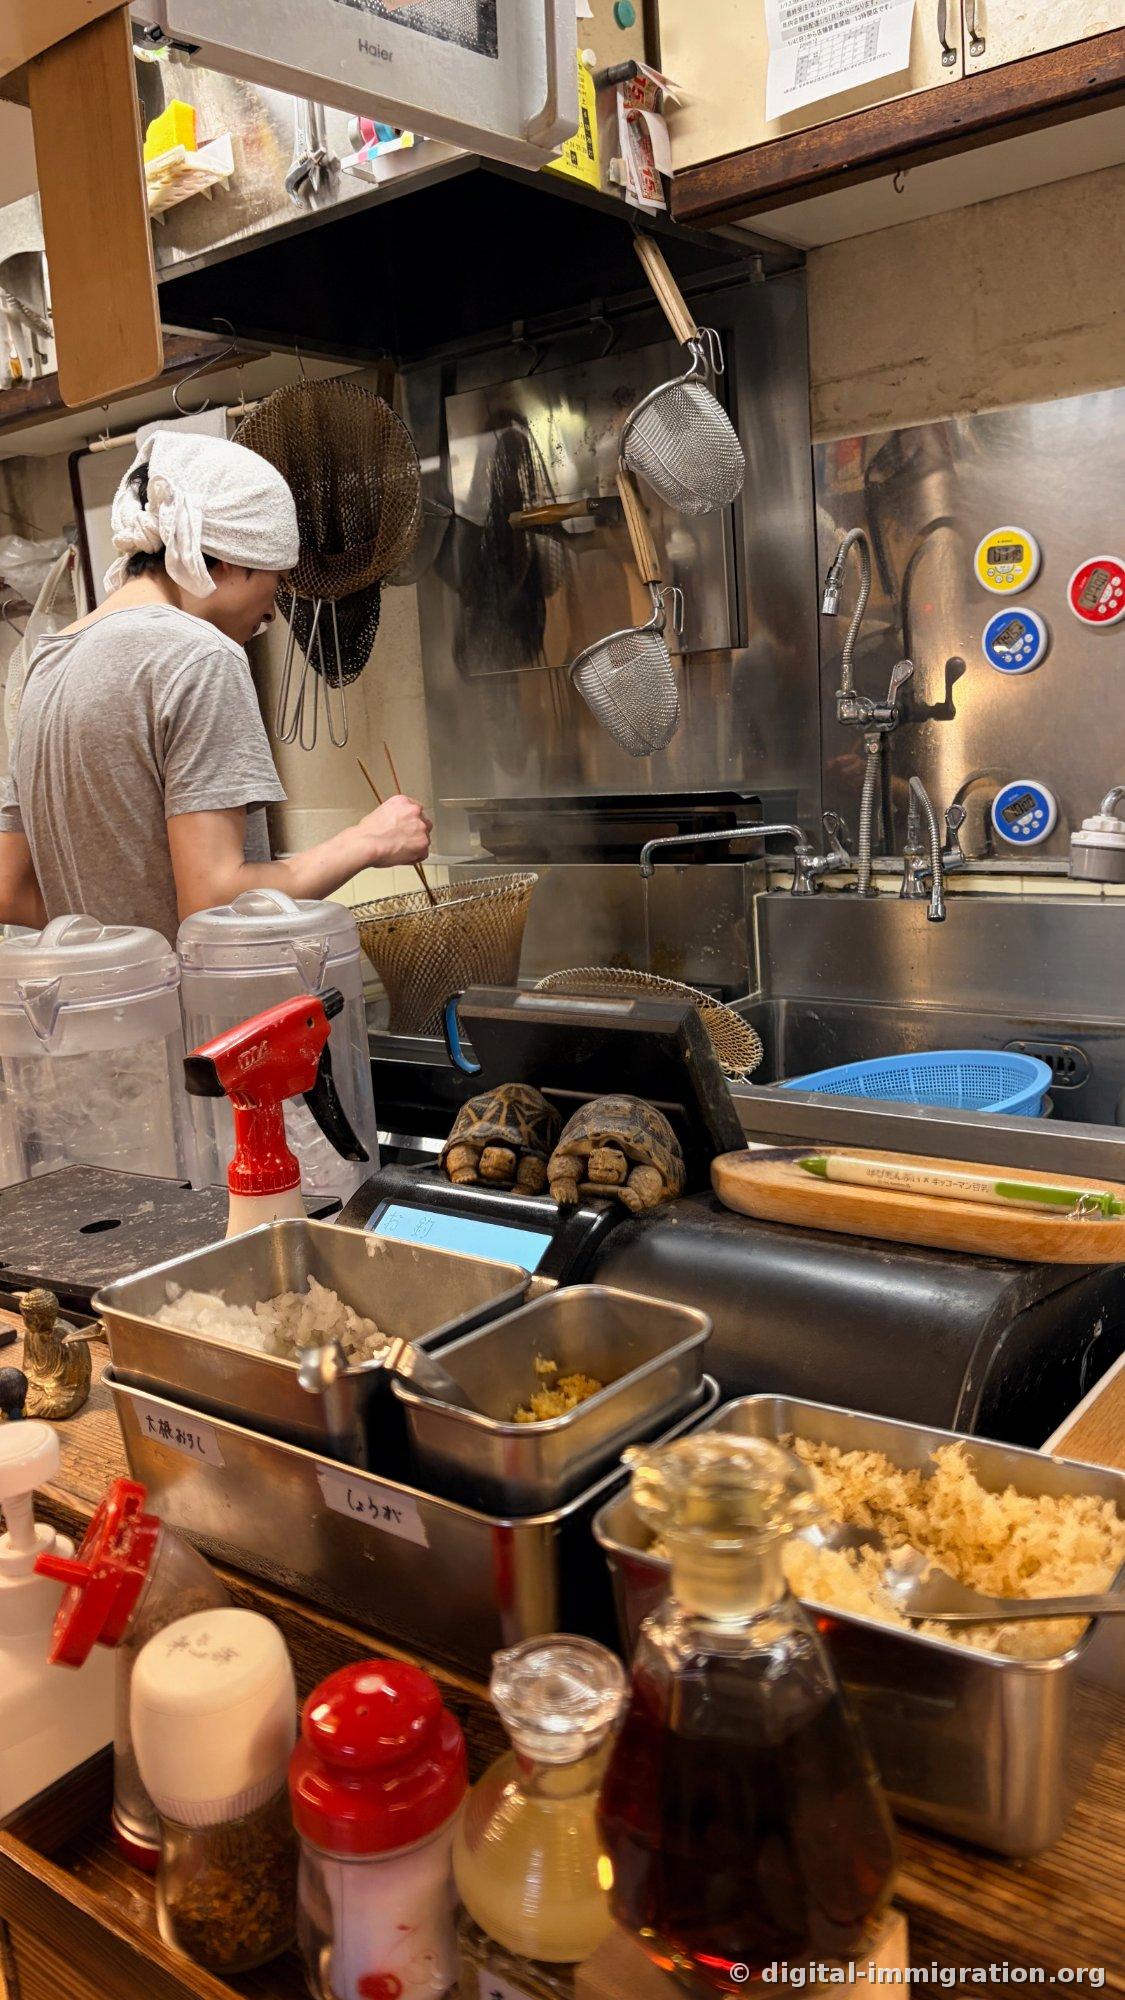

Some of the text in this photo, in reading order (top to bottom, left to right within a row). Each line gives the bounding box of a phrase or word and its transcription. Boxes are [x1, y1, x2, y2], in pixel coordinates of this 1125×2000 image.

[358, 38, 393, 62] Haier
[145, 1414, 206, 1455] 大根おろし
[347, 1488, 402, 1524] しょうが
